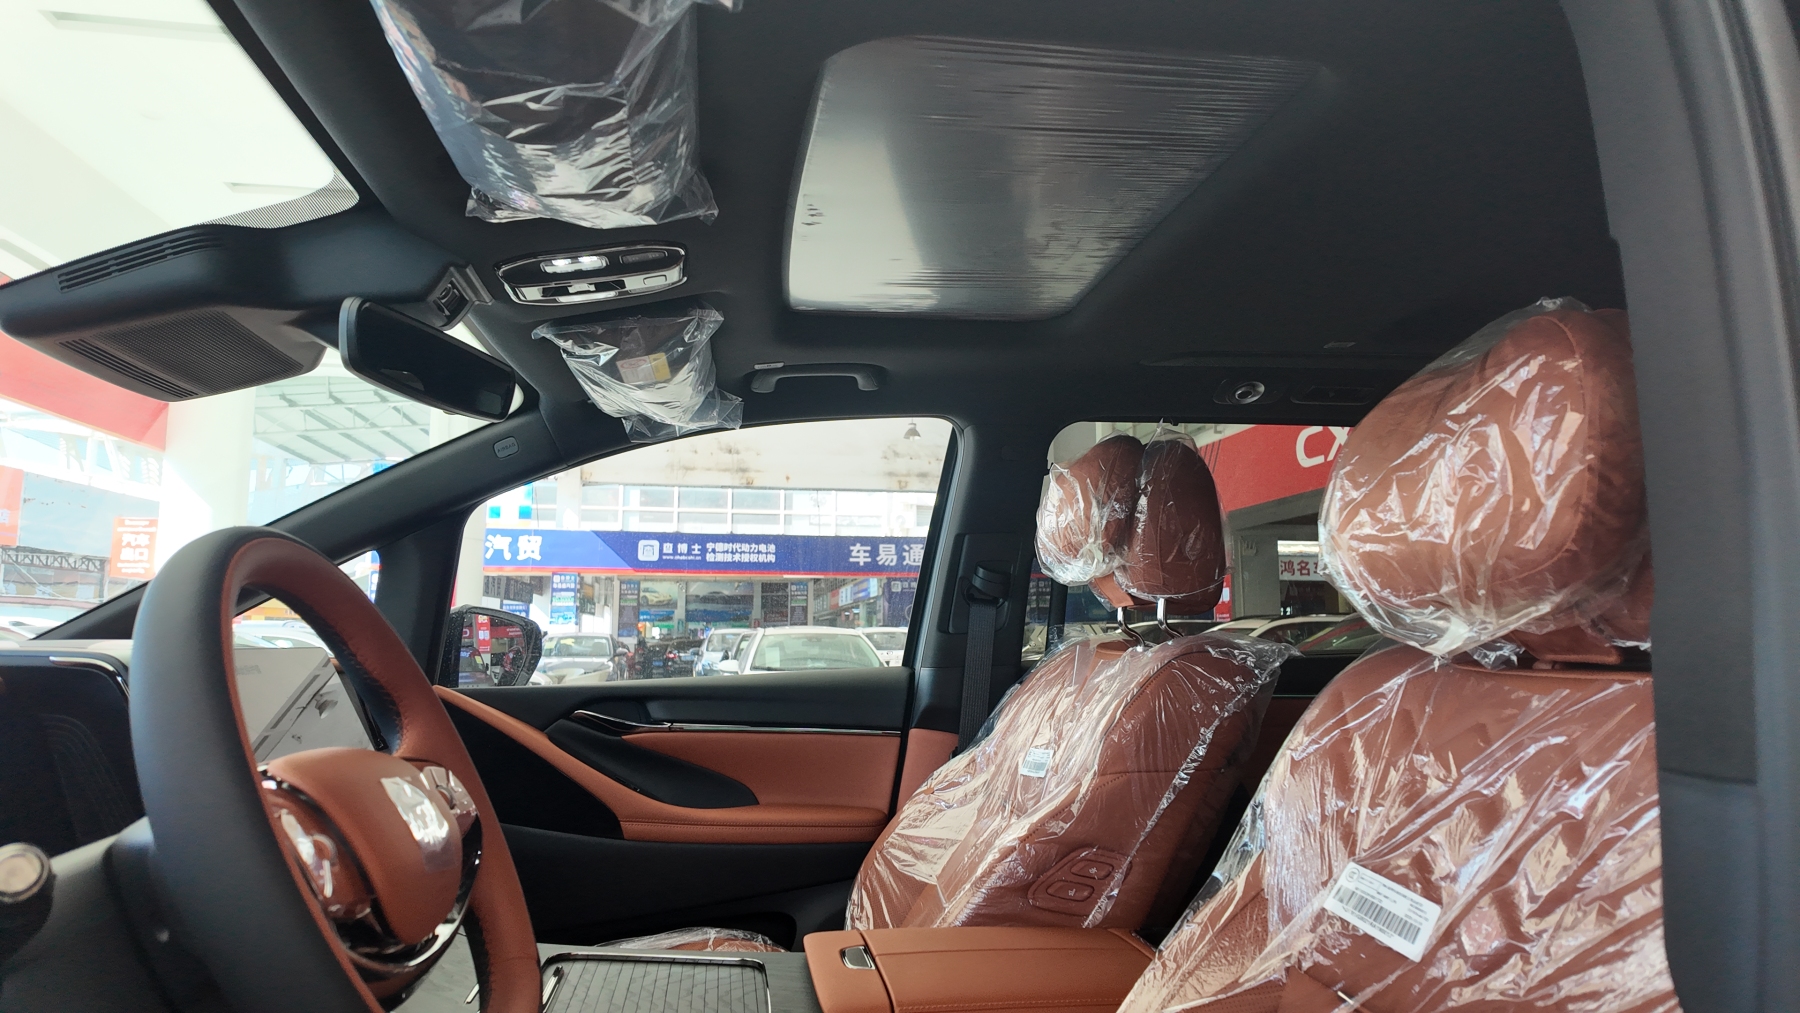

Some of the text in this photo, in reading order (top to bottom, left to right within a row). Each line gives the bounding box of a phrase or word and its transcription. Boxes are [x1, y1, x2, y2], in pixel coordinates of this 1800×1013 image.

[485, 534, 542, 561] 汽贸
[706, 542, 776, 553] 宁德时代动力电池
[849, 543, 924, 566] 车易通
[706, 552, 776, 563] 检测技术授权机构
